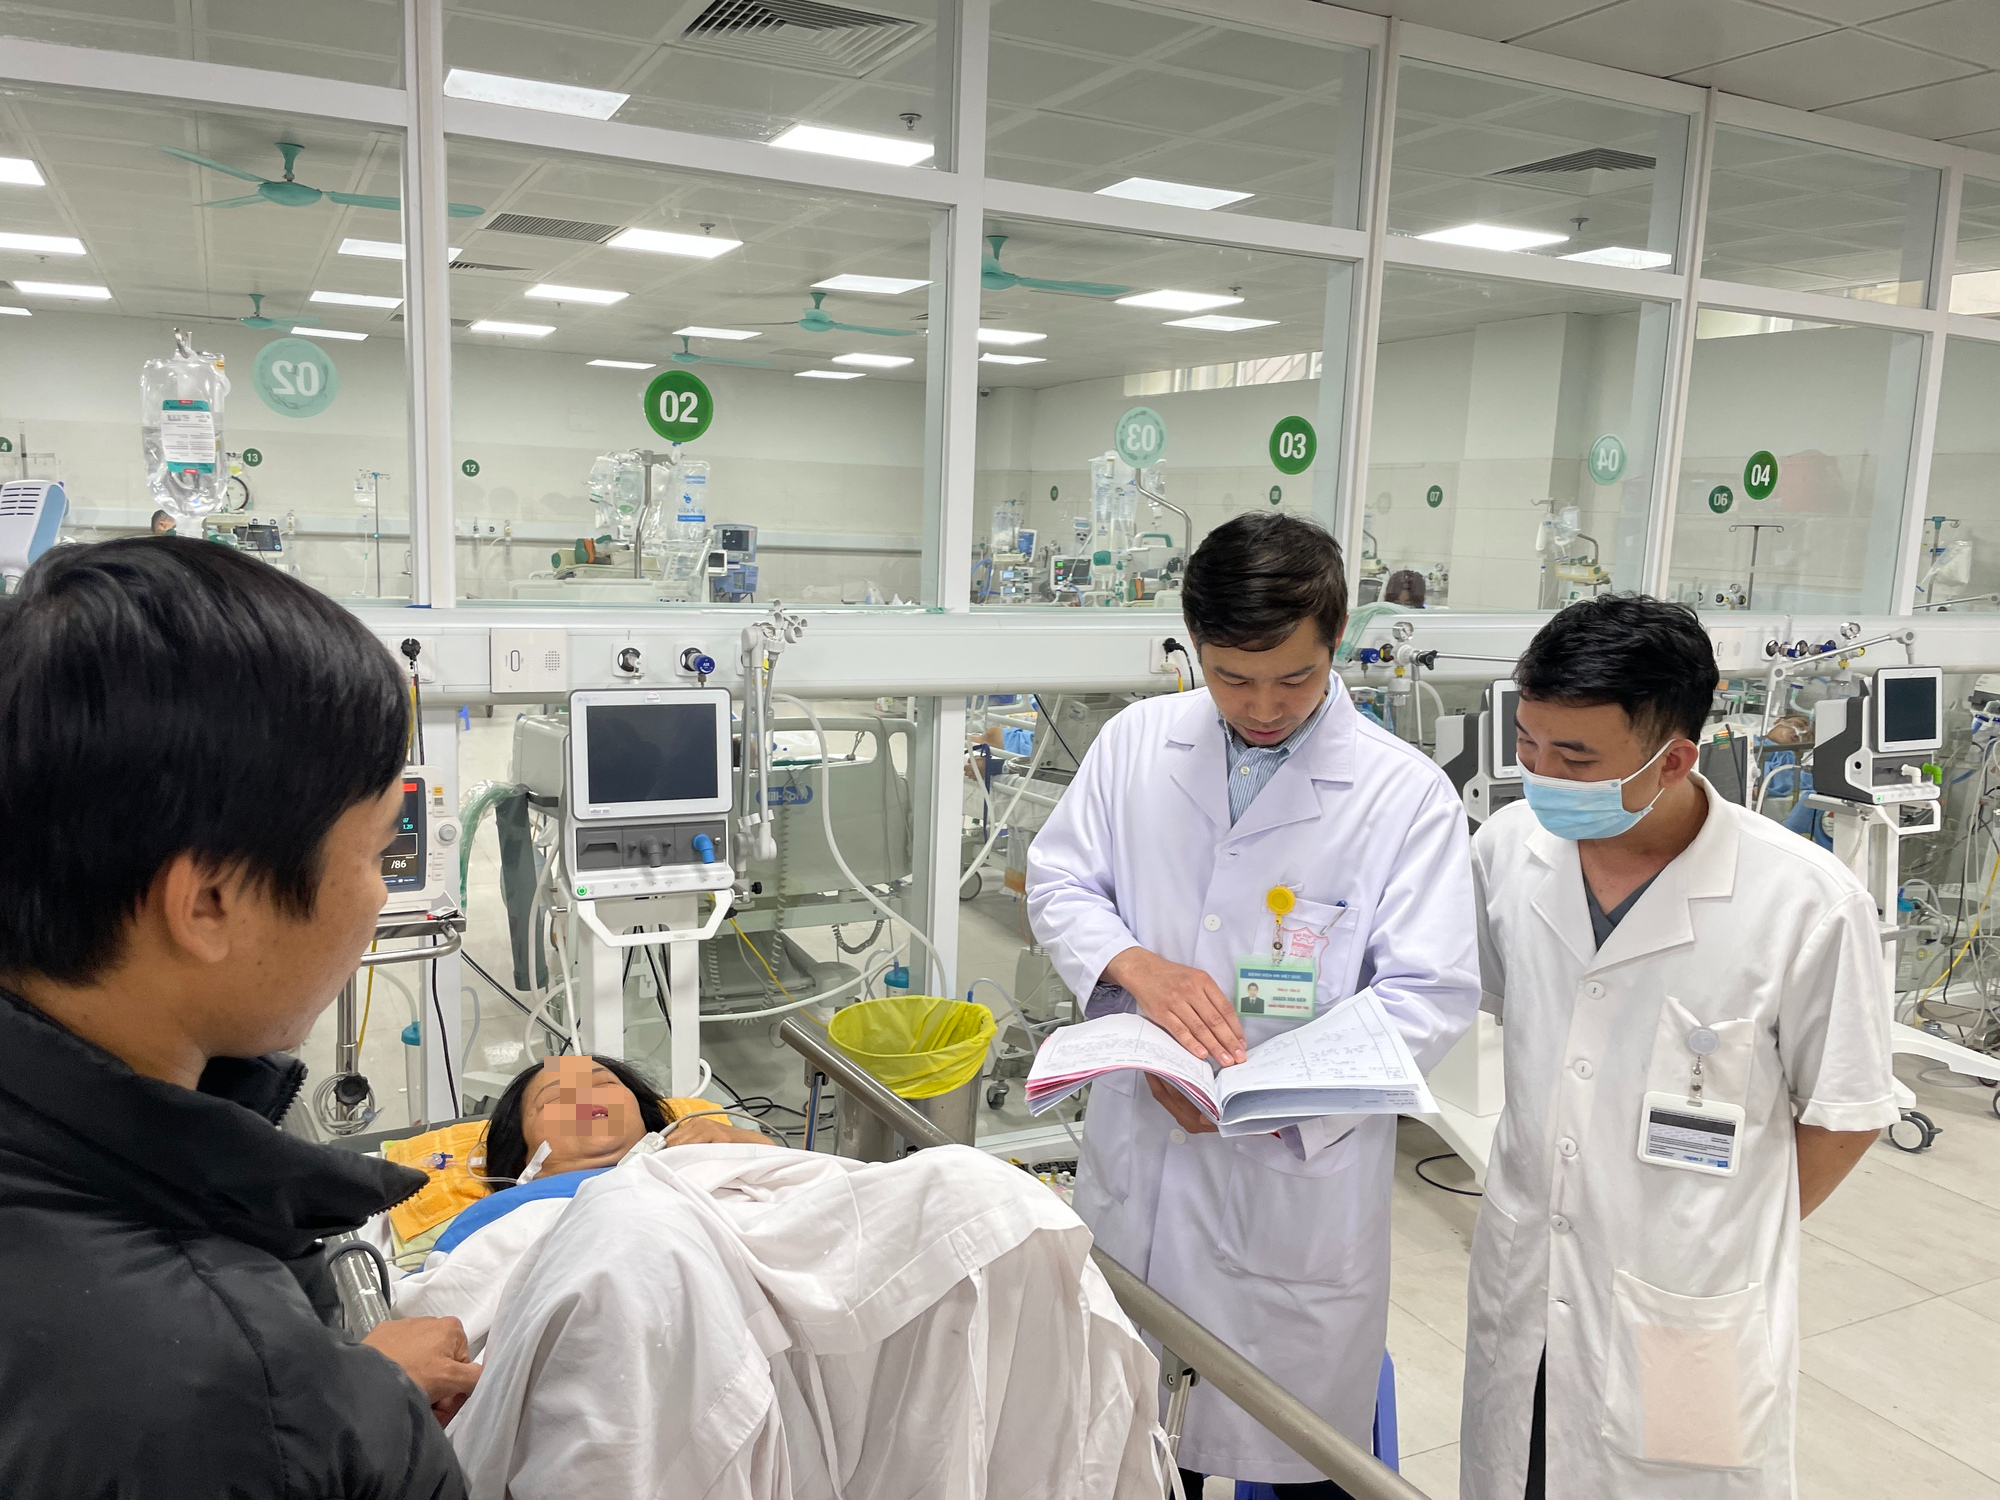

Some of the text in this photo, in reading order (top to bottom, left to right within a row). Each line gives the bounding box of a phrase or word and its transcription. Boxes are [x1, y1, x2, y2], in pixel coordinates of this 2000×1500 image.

[660, 390, 698, 423] 02
[1279, 431, 1307, 459] 03
[246, 453, 259, 463] 13
[465, 464, 477, 473] 12
[1751, 464, 1771, 486] 04
[1430, 491, 1440, 502] 07
[1713, 493, 1728, 507] 06
